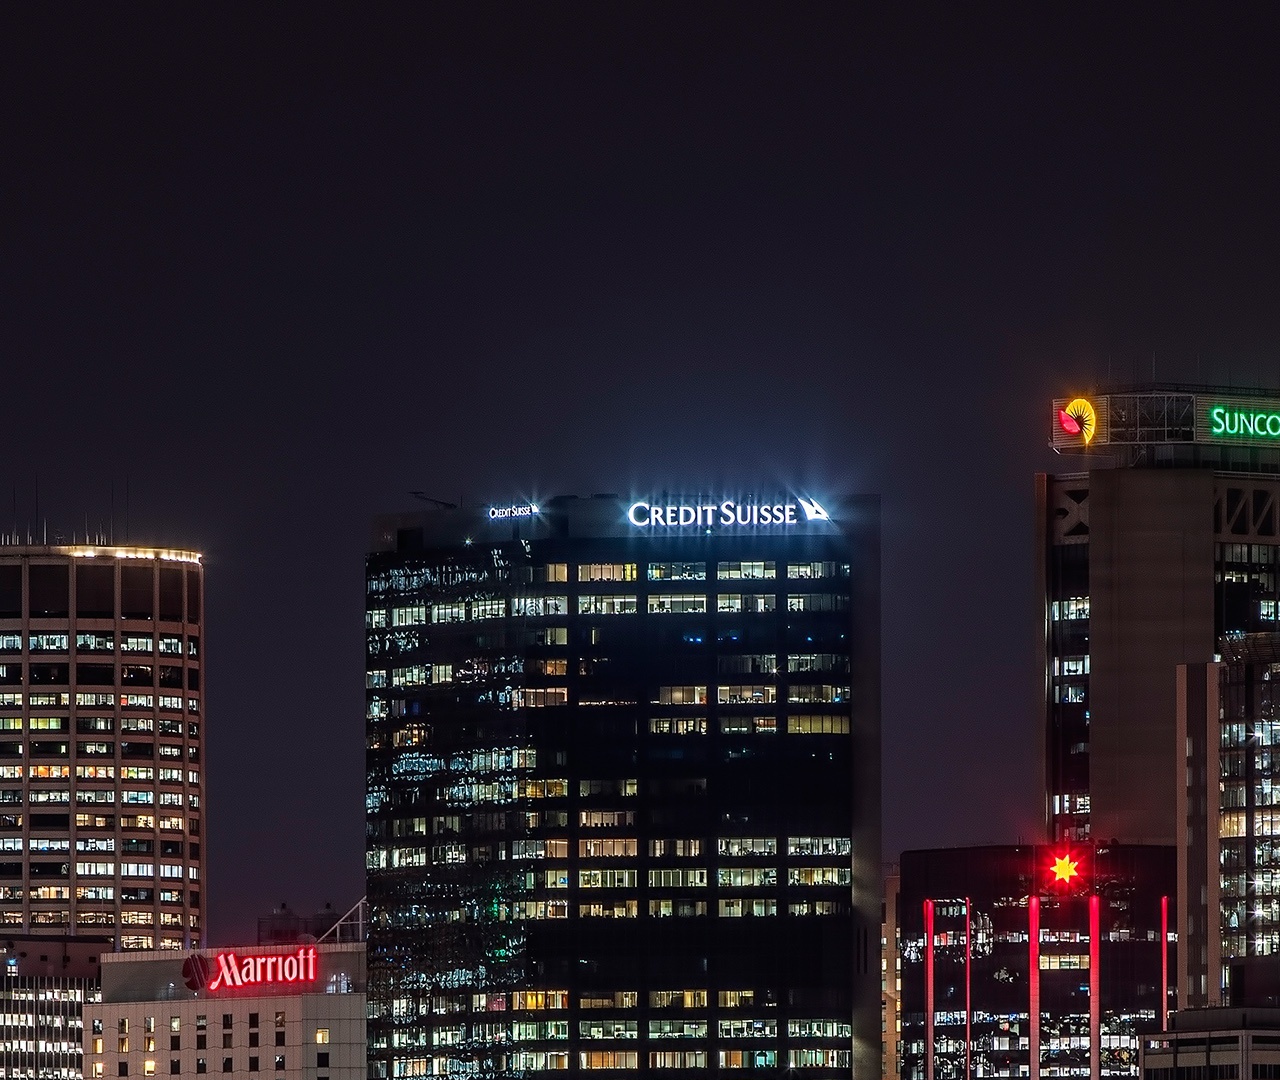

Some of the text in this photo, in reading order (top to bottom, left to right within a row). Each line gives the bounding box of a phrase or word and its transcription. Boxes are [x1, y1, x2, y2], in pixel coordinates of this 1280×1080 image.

[628, 500, 797, 527] CREDIT SUISSE
[209, 948, 317, 991] Marriott
